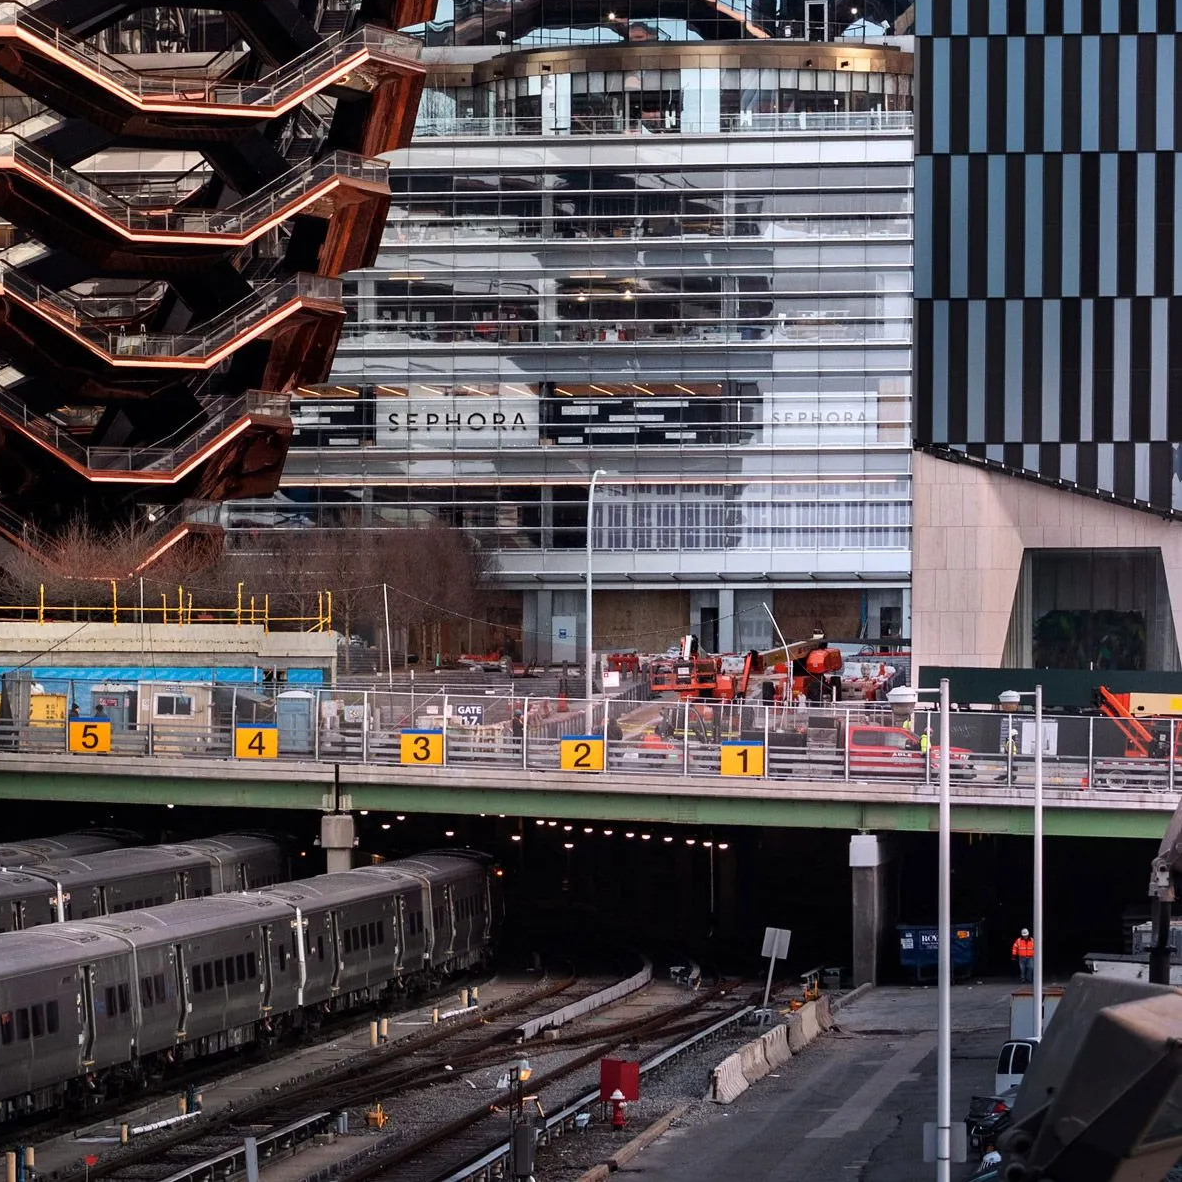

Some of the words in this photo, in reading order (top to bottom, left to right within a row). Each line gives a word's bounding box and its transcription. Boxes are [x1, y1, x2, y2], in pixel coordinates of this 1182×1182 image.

[387, 412, 528, 432] SEPHORA
[771, 411, 867, 427] SEPHORA
[457, 706, 482, 714] GATE
[82, 725, 98, 748] 5
[248, 732, 265, 755] 4
[414, 737, 430, 760] 3
[574, 744, 590, 767] 2
[737, 749, 748, 772] 1
